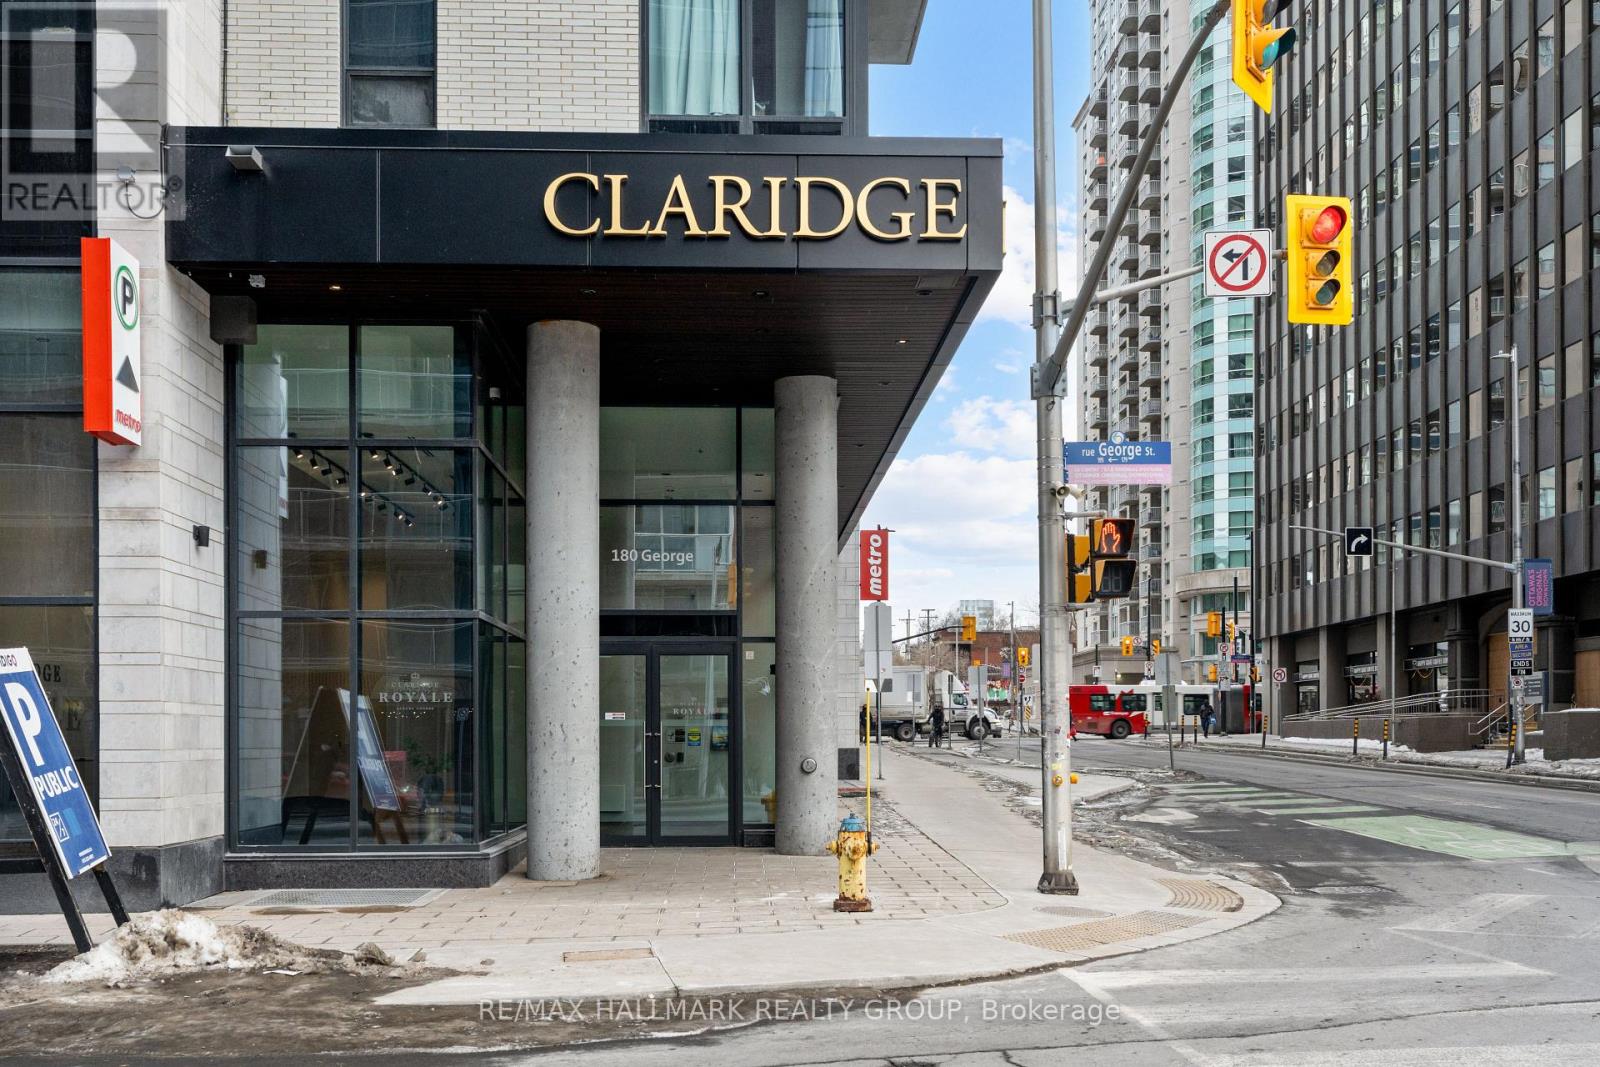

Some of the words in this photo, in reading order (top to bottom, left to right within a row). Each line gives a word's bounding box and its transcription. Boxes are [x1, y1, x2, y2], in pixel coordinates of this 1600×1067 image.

[543, 172, 968, 242] CLARIDGE
[121, 275, 133, 316] P
[115, 408, 141, 433] metro
[1081, 447, 1095, 457] rue
[1098, 442, 1142, 460] George
[1145, 446, 1156, 456] St.
[611, 549, 638, 562] 180
[641, 549, 694, 565] George
[868, 533, 883, 596] metro
[1511, 620, 1531, 633] 30
[378, 692, 454, 703] ROYALE
[4, 682, 44, 767] P
[35, 766, 79, 800] PUBLIC
